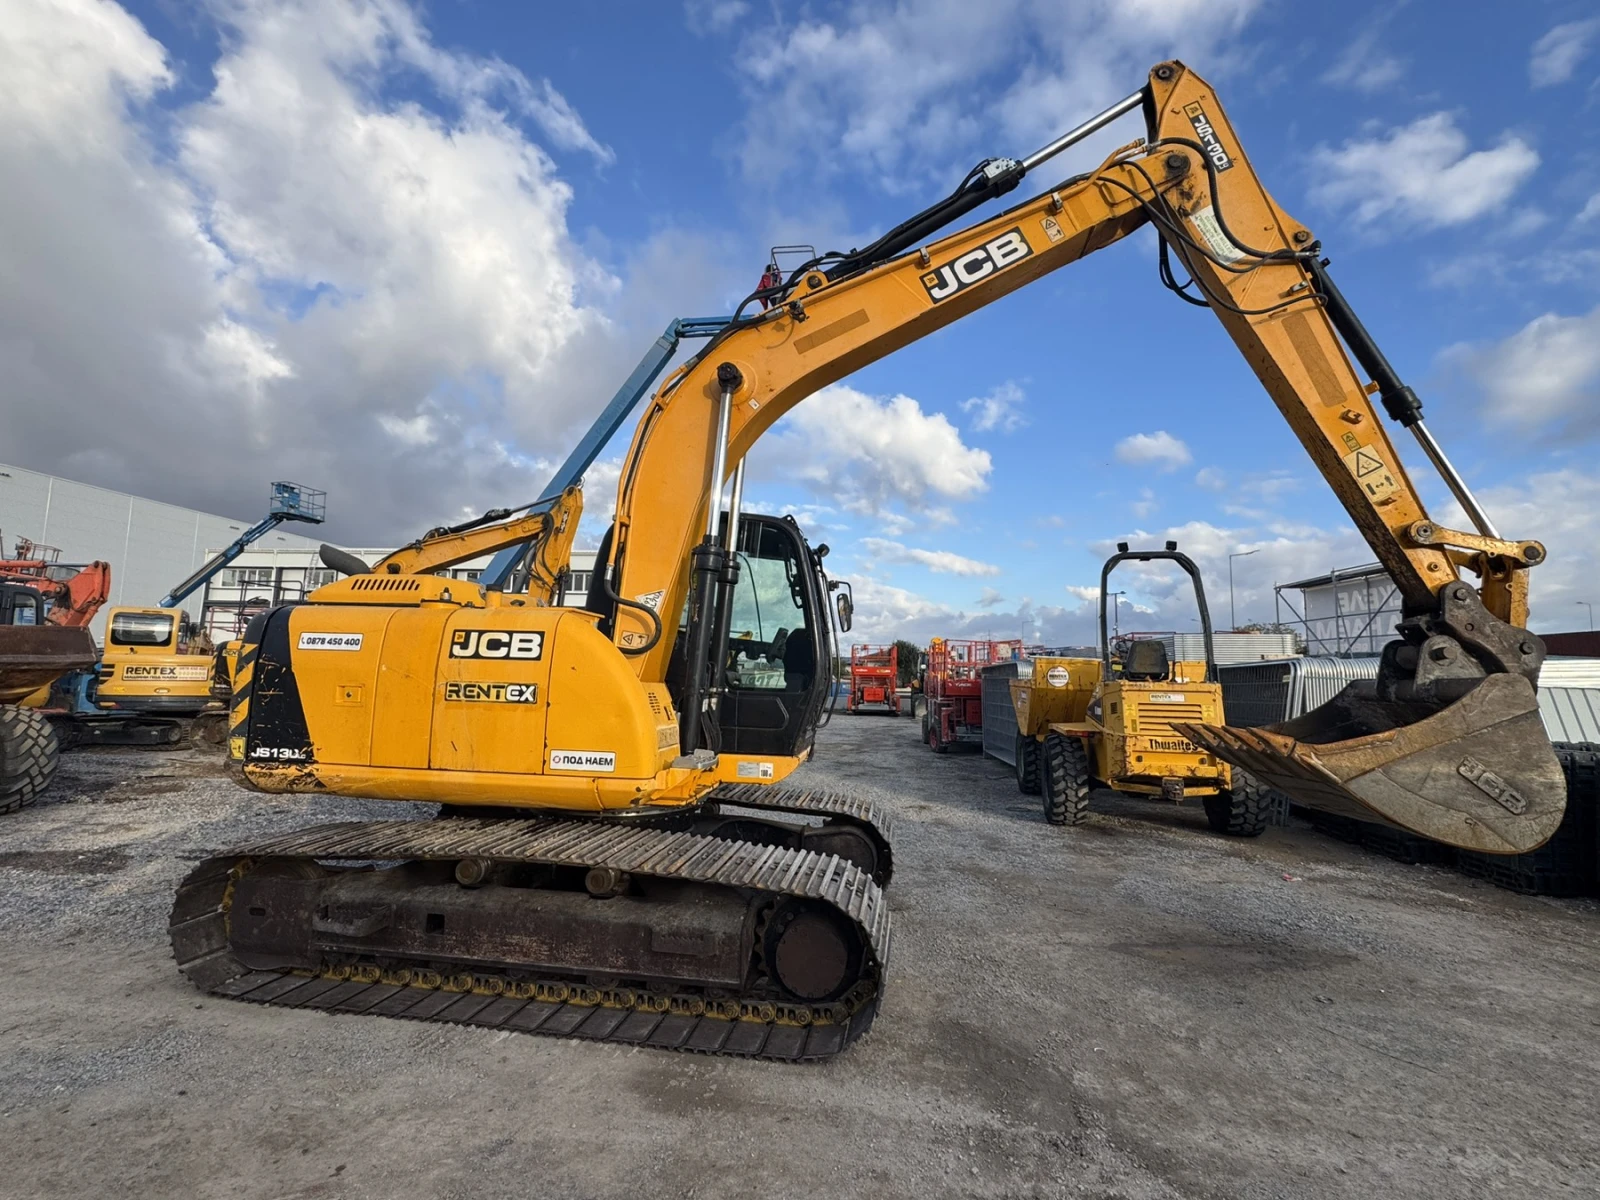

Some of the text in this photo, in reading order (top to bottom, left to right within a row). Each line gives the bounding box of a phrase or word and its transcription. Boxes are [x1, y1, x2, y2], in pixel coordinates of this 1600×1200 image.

[929, 231, 1030, 300] JCB
[306, 636, 361, 646] 0878 450 400
[452, 631, 541, 659] JCB
[125, 666, 177, 675] RENTEX
[447, 683, 536, 702] RENTEX
[1148, 738, 1199, 752] Thwaites
[562, 755, 613, 766] ПОД НАЕМ
